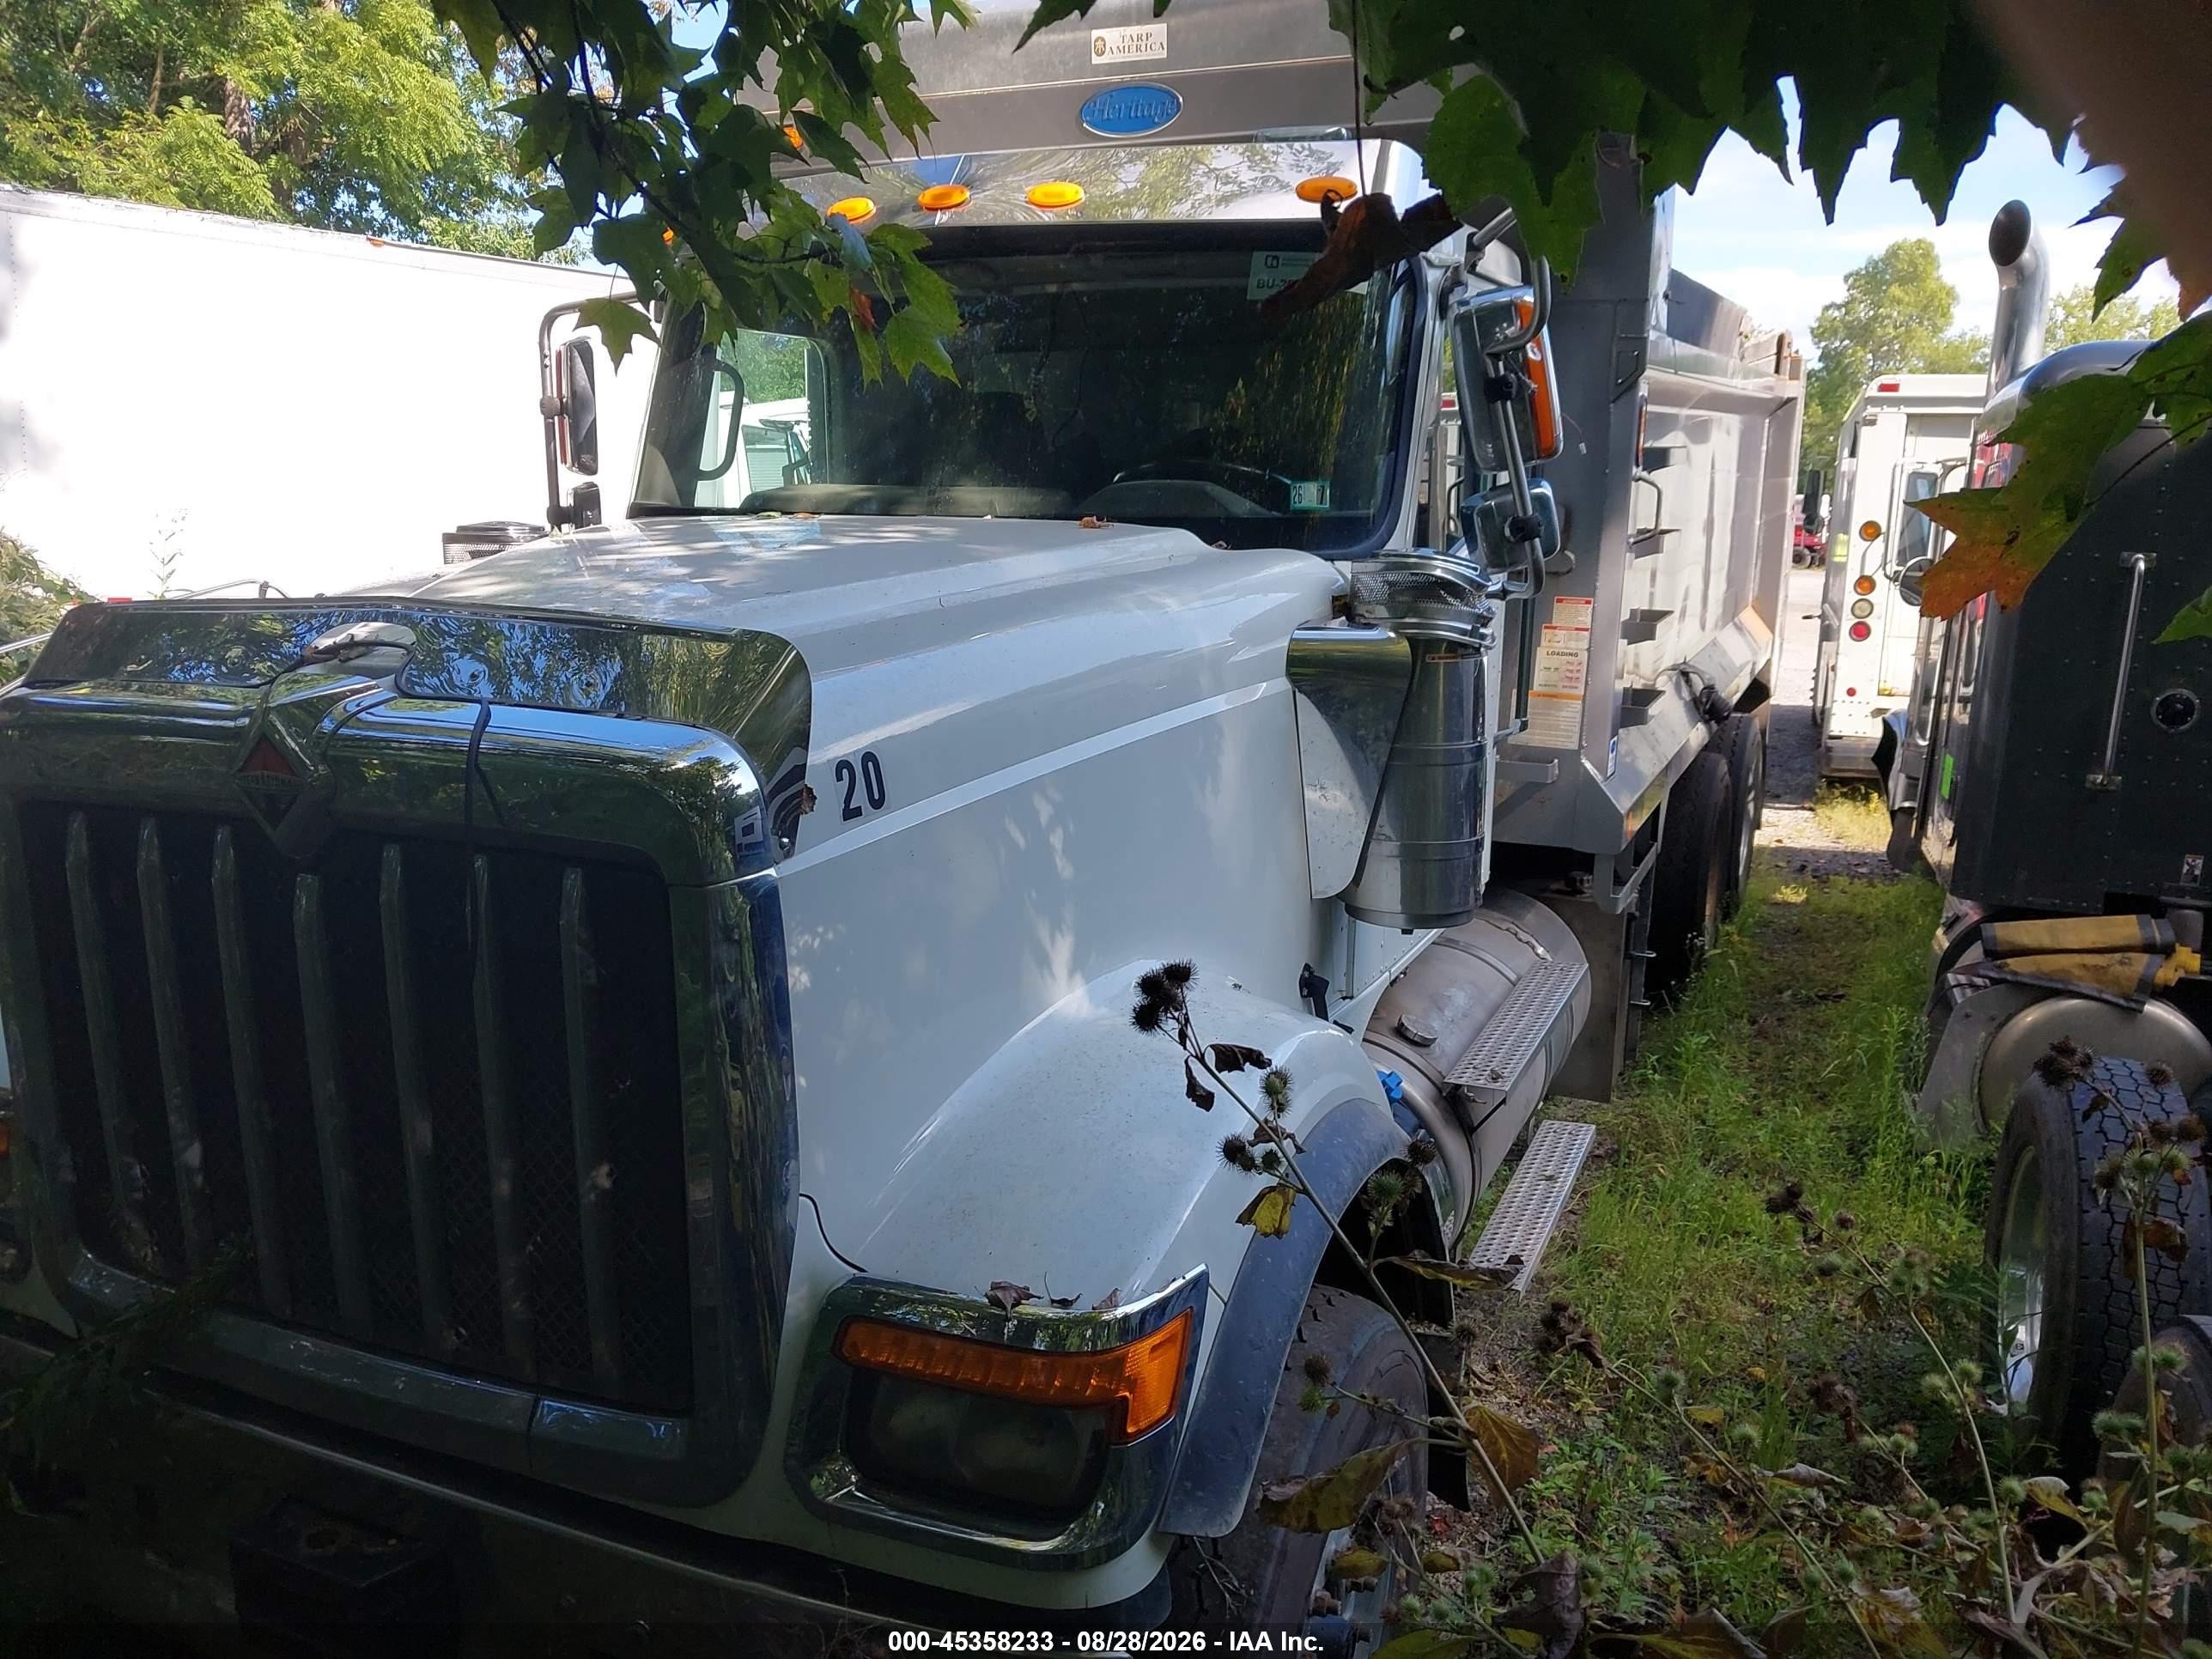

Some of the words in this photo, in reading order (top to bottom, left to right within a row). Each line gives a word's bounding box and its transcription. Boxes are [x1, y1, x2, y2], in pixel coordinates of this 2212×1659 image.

[1121, 32, 1153, 44] TARP
[1108, 41, 1165, 56] AMERICA
[1292, 485, 1303, 505] 26
[1318, 485, 1325, 505] 7
[835, 750, 886, 822] 20
